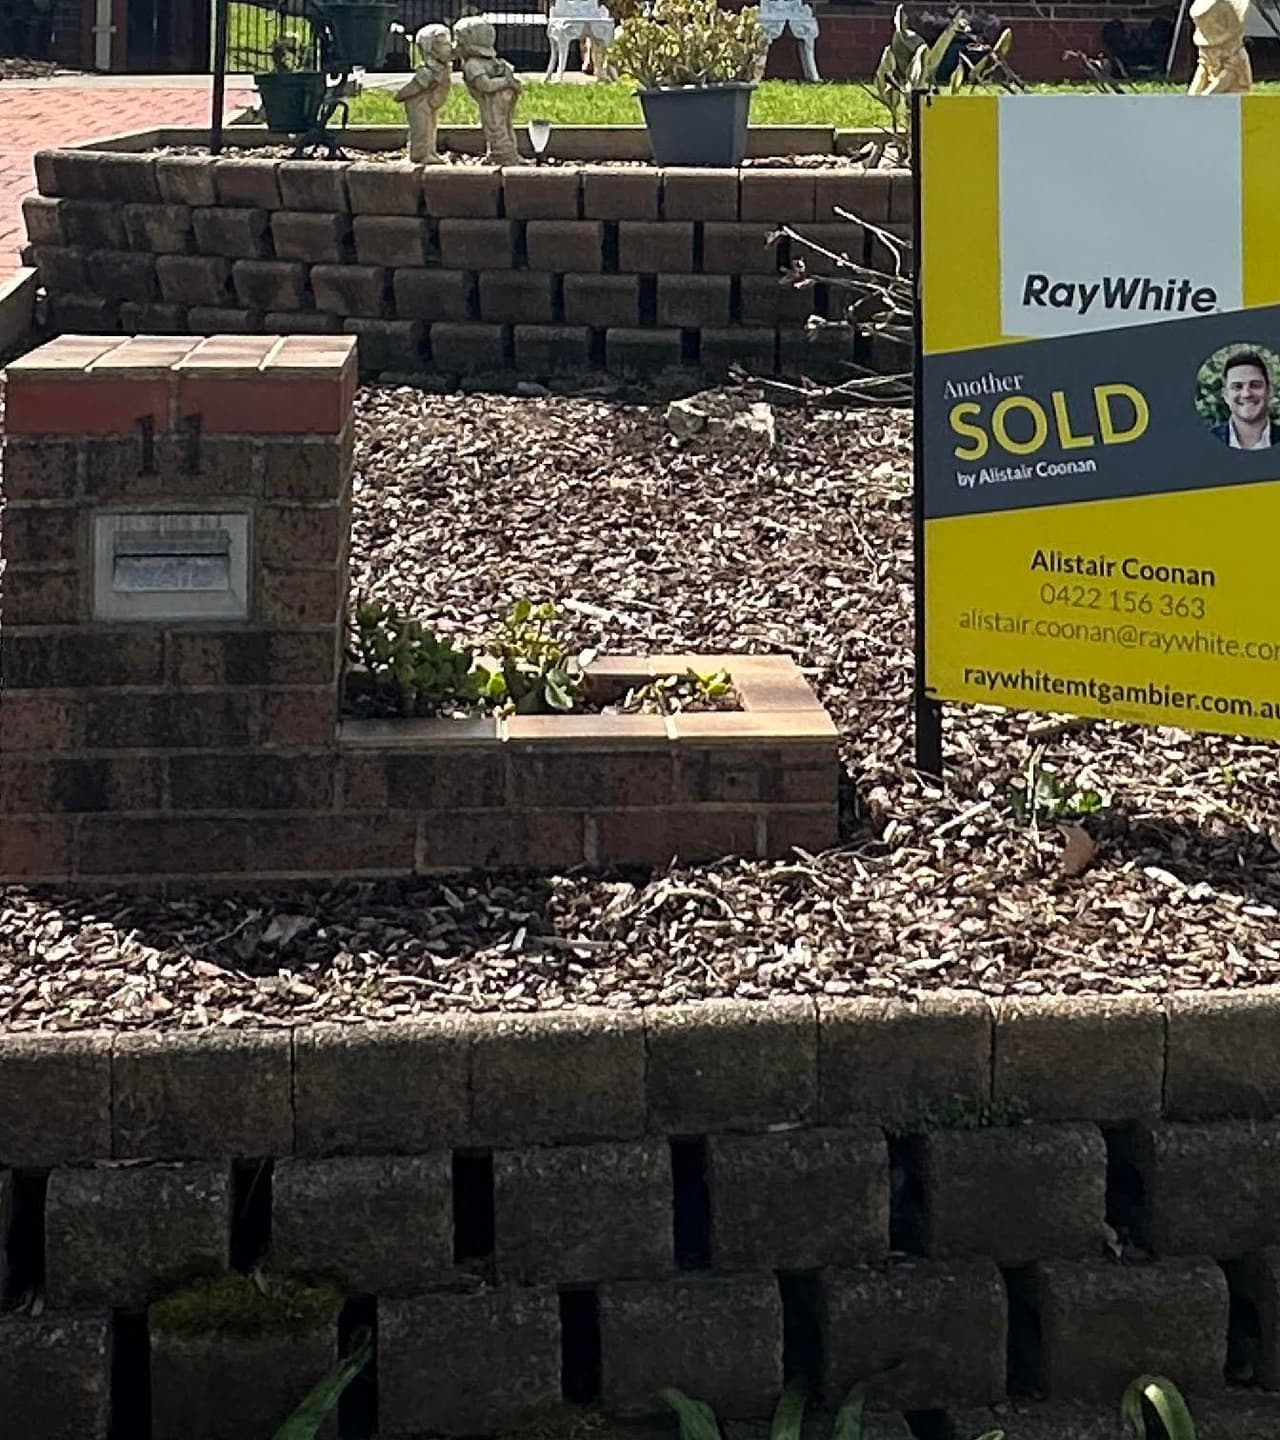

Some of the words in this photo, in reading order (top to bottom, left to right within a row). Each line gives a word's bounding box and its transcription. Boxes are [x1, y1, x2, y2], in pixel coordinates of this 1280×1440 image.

[943, 372, 1024, 400] Another
[949, 383, 1150, 461] SOLD
[134, 412, 206, 478] 11
[957, 471, 976, 488] by
[979, 464, 1033, 485] Alistair
[1036, 458, 1097, 477] Coonan
[1031, 549, 1117, 577] Alistair
[1121, 558, 1216, 587] Coonan
[1040, 583, 1102, 609] 0422
[1111, 588, 1153, 615] 156
[1159, 594, 1206, 620] 363
